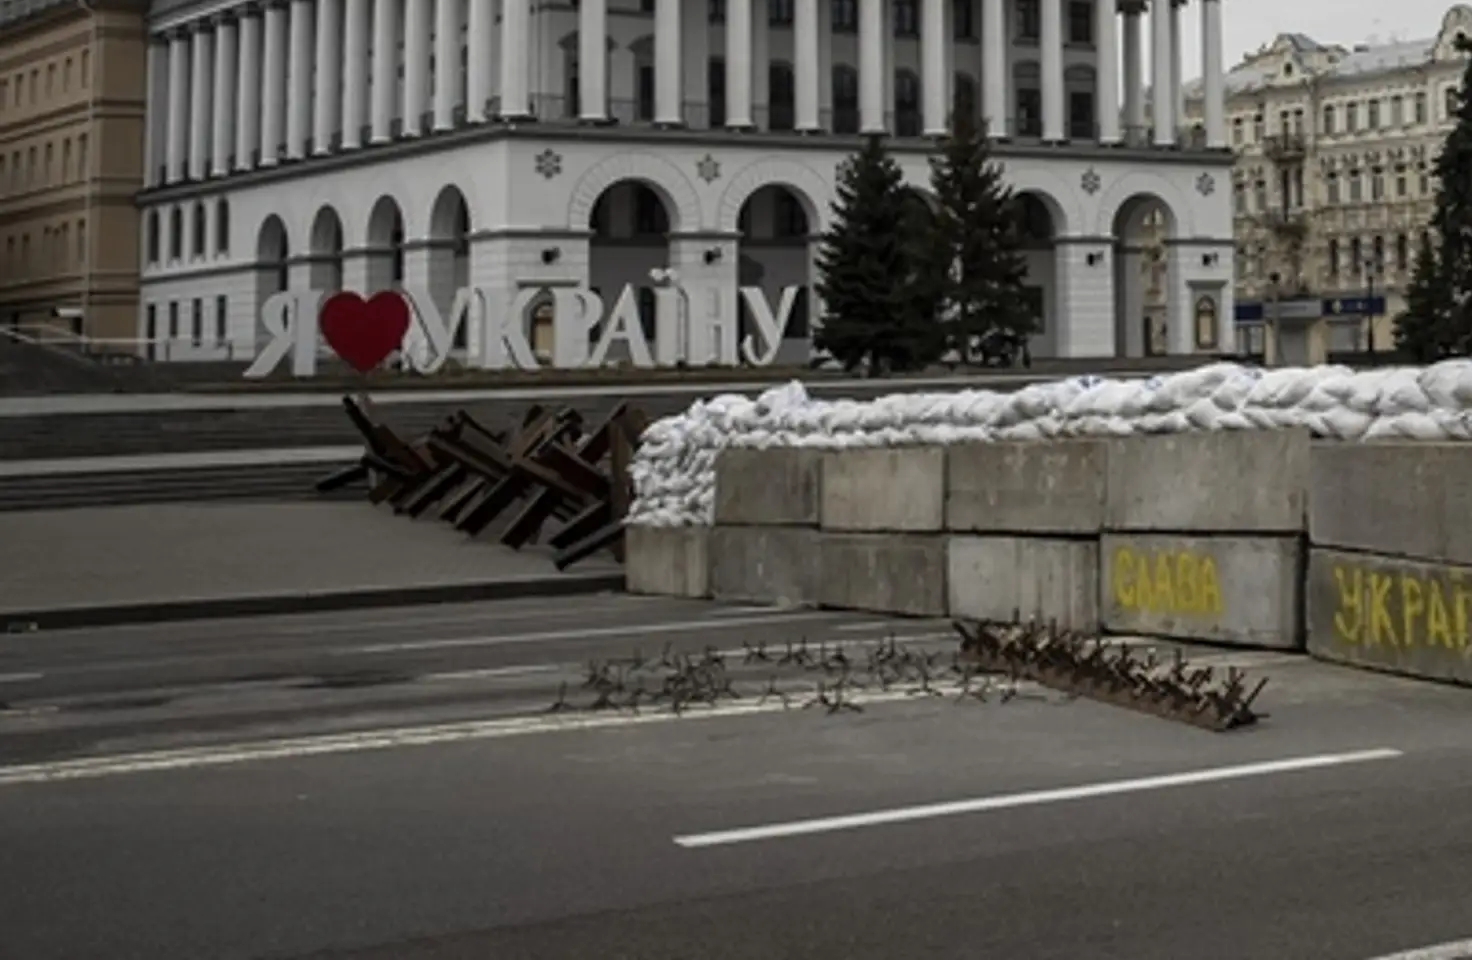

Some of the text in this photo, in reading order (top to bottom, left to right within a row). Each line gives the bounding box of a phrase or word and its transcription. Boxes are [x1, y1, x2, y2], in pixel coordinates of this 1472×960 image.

[243, 268, 799, 377] Я УКРАЇНУ
[1114, 548, 1222, 613] СЛАВА
